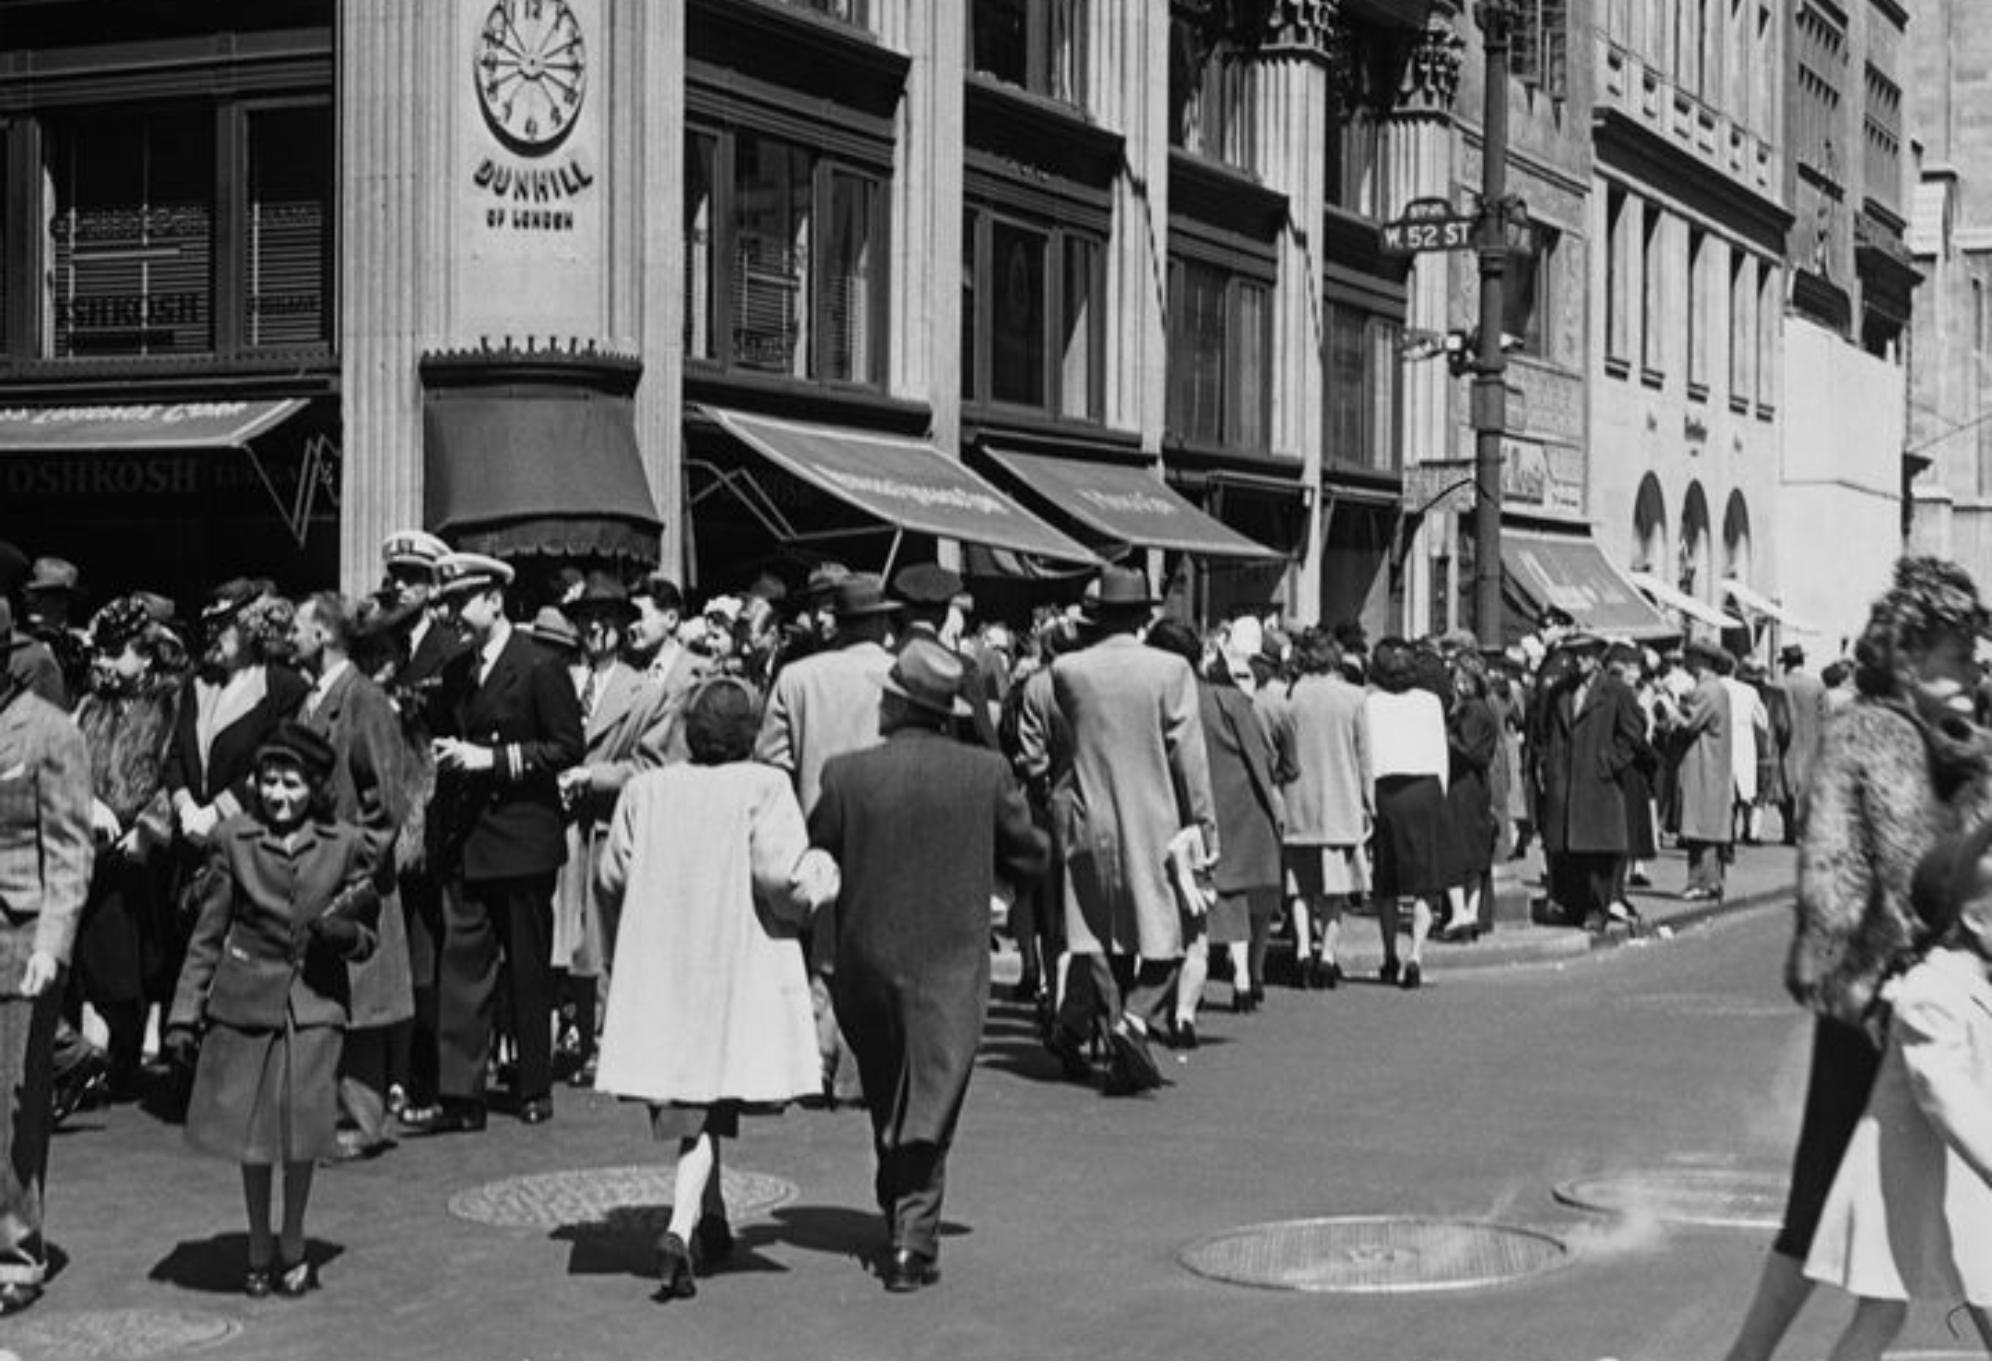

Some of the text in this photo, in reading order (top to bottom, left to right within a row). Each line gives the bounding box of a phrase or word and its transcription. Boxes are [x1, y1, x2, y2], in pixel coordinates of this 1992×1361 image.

[475, 160, 592, 202] DUNHILL
[487, 209, 574, 229] OF LONDON
[1408, 226, 1438, 248] 52
[1445, 223, 1471, 244] ST
[9, 459, 198, 492] OSHKOSH
